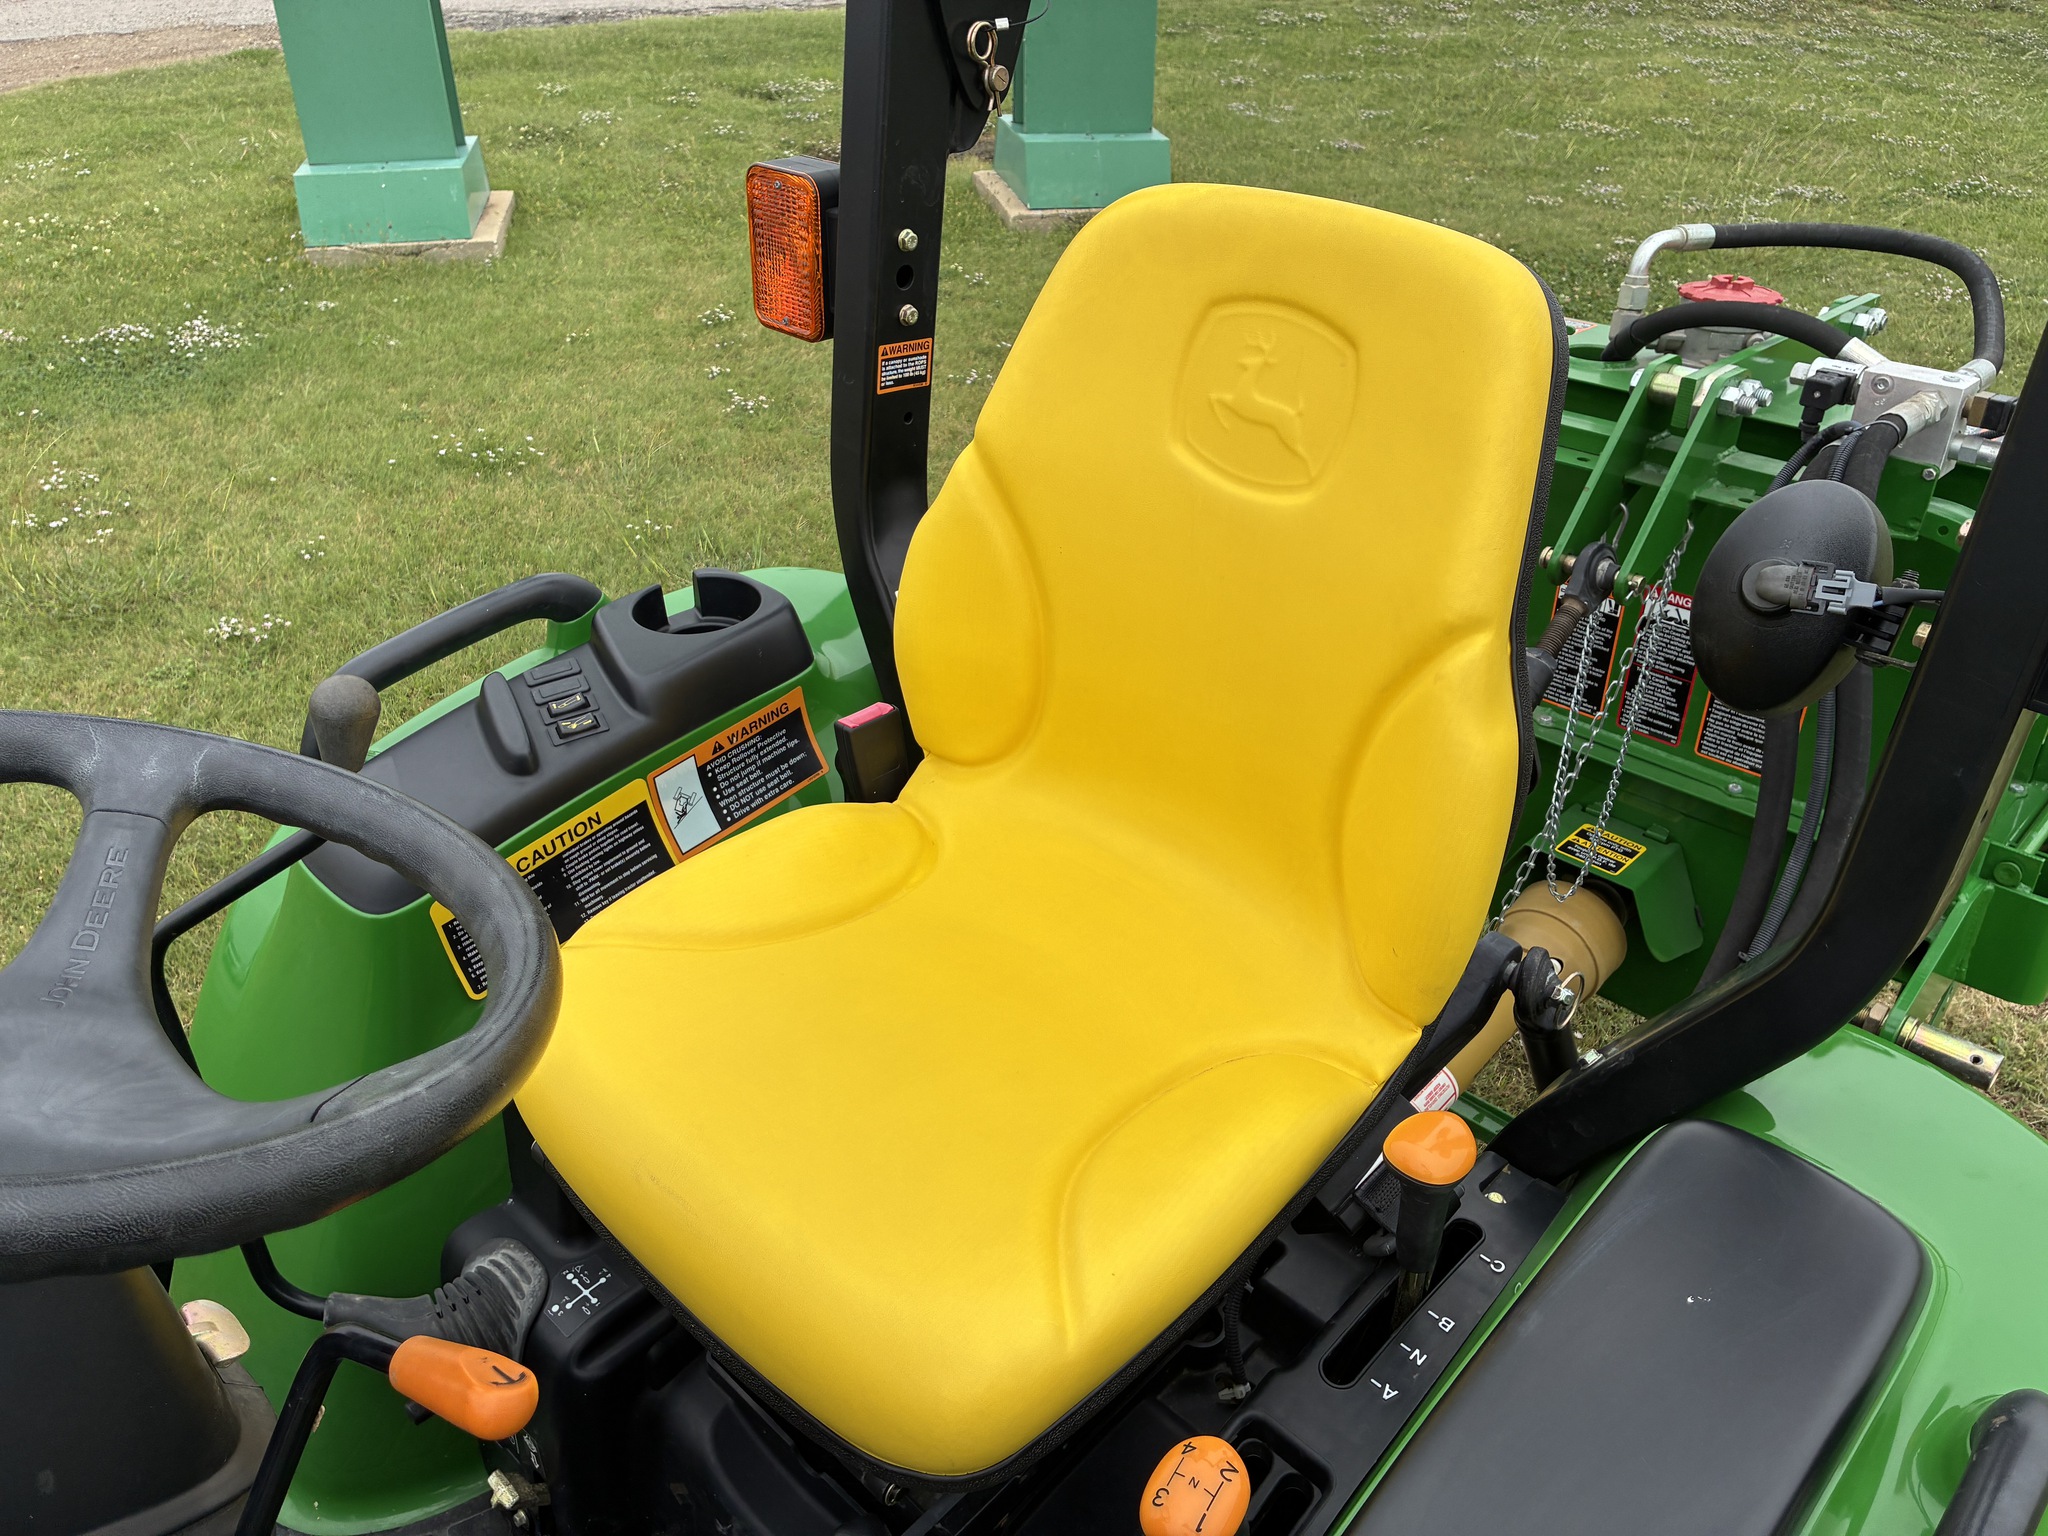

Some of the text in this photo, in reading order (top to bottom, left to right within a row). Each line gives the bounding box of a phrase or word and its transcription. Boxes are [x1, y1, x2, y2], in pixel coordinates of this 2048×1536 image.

[889, 341, 929, 355] WARNING
[727, 702, 789, 745] WARNING
[706, 736, 762, 771] AVOID CRUSHING:
[715, 729, 786, 774] Keep Rollover Protective
[717, 736, 787, 781] Structure fully extended.
[719, 780, 729, 789] Do
[730, 773, 740, 783] not
[740, 764, 756, 777] jump
[762, 746, 786, 763] machine
[786, 739, 799, 748] tips.
[719, 794, 737, 807] When
[738, 778, 764, 796] structure
[765, 767, 780, 779] must
[722, 770, 763, 796] Use seat belt.
[729, 770, 793, 811] DO NOT use seat belt.
[733, 779, 794, 818] Drive with extra care.
[516, 811, 602, 874] CAUTION
[1601, 831, 1642, 850] AUTION
[39, 846, 129, 1009] JOHN DEERE
[1490, 1258, 1506, 1274] C
[1438, 1316, 1455, 1333] B
[1409, 1348, 1427, 1366] N
[1382, 1383, 1399, 1400] A
[1181, 1441, 1197, 1455] 4
[1188, 1476, 1200, 1489] N
[1219, 1460, 1239, 1482] 2
[1152, 1487, 1169, 1507] 3
[1195, 1512, 1207, 1533] 1
